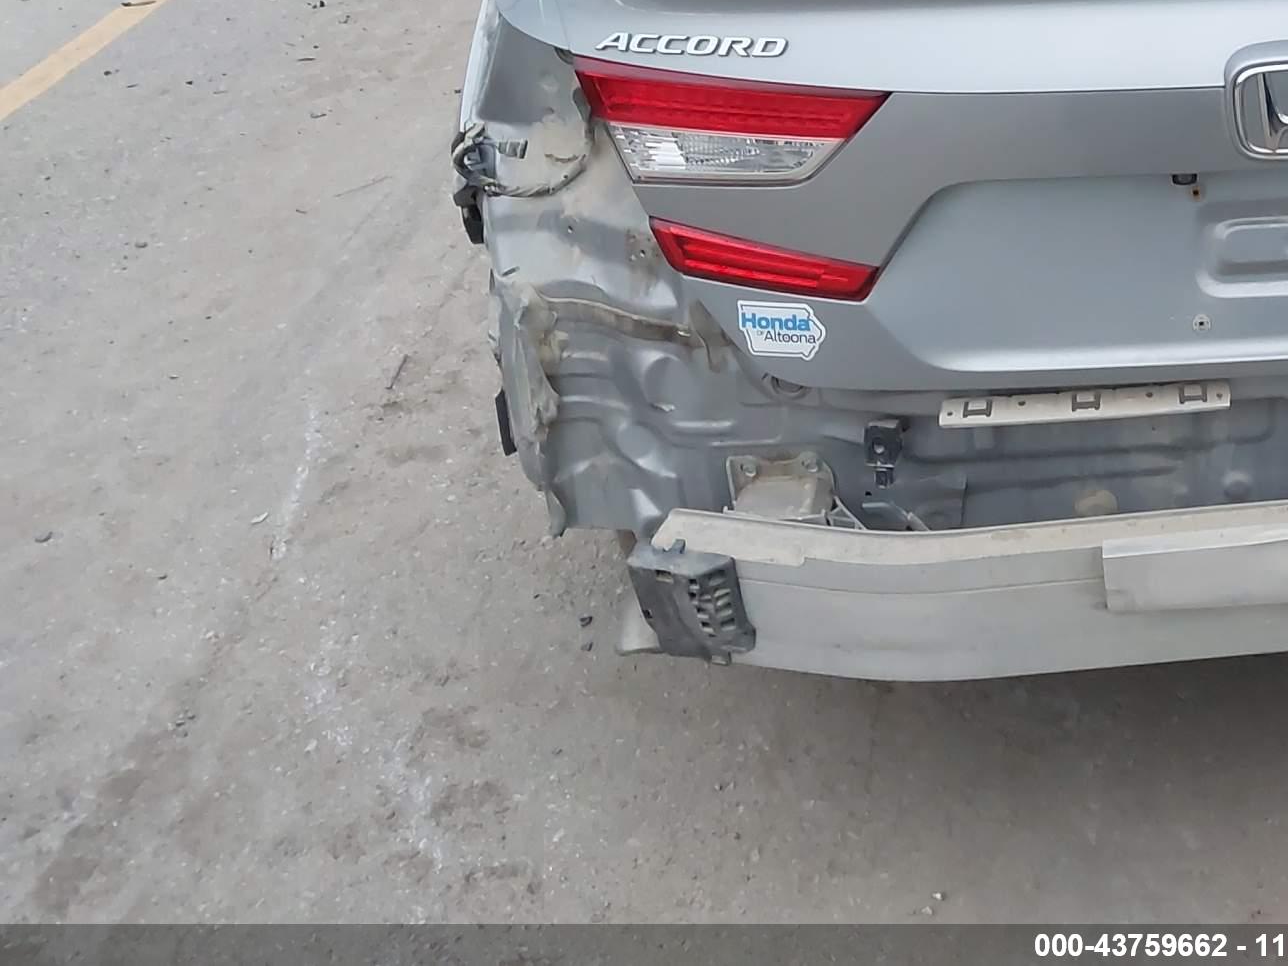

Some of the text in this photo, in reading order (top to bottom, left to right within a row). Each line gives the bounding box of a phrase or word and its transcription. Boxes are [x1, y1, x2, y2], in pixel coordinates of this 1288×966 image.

[594, 31, 789, 58] ACCORD
[741, 312, 811, 332] Honda
[764, 328, 817, 344] Altoona
